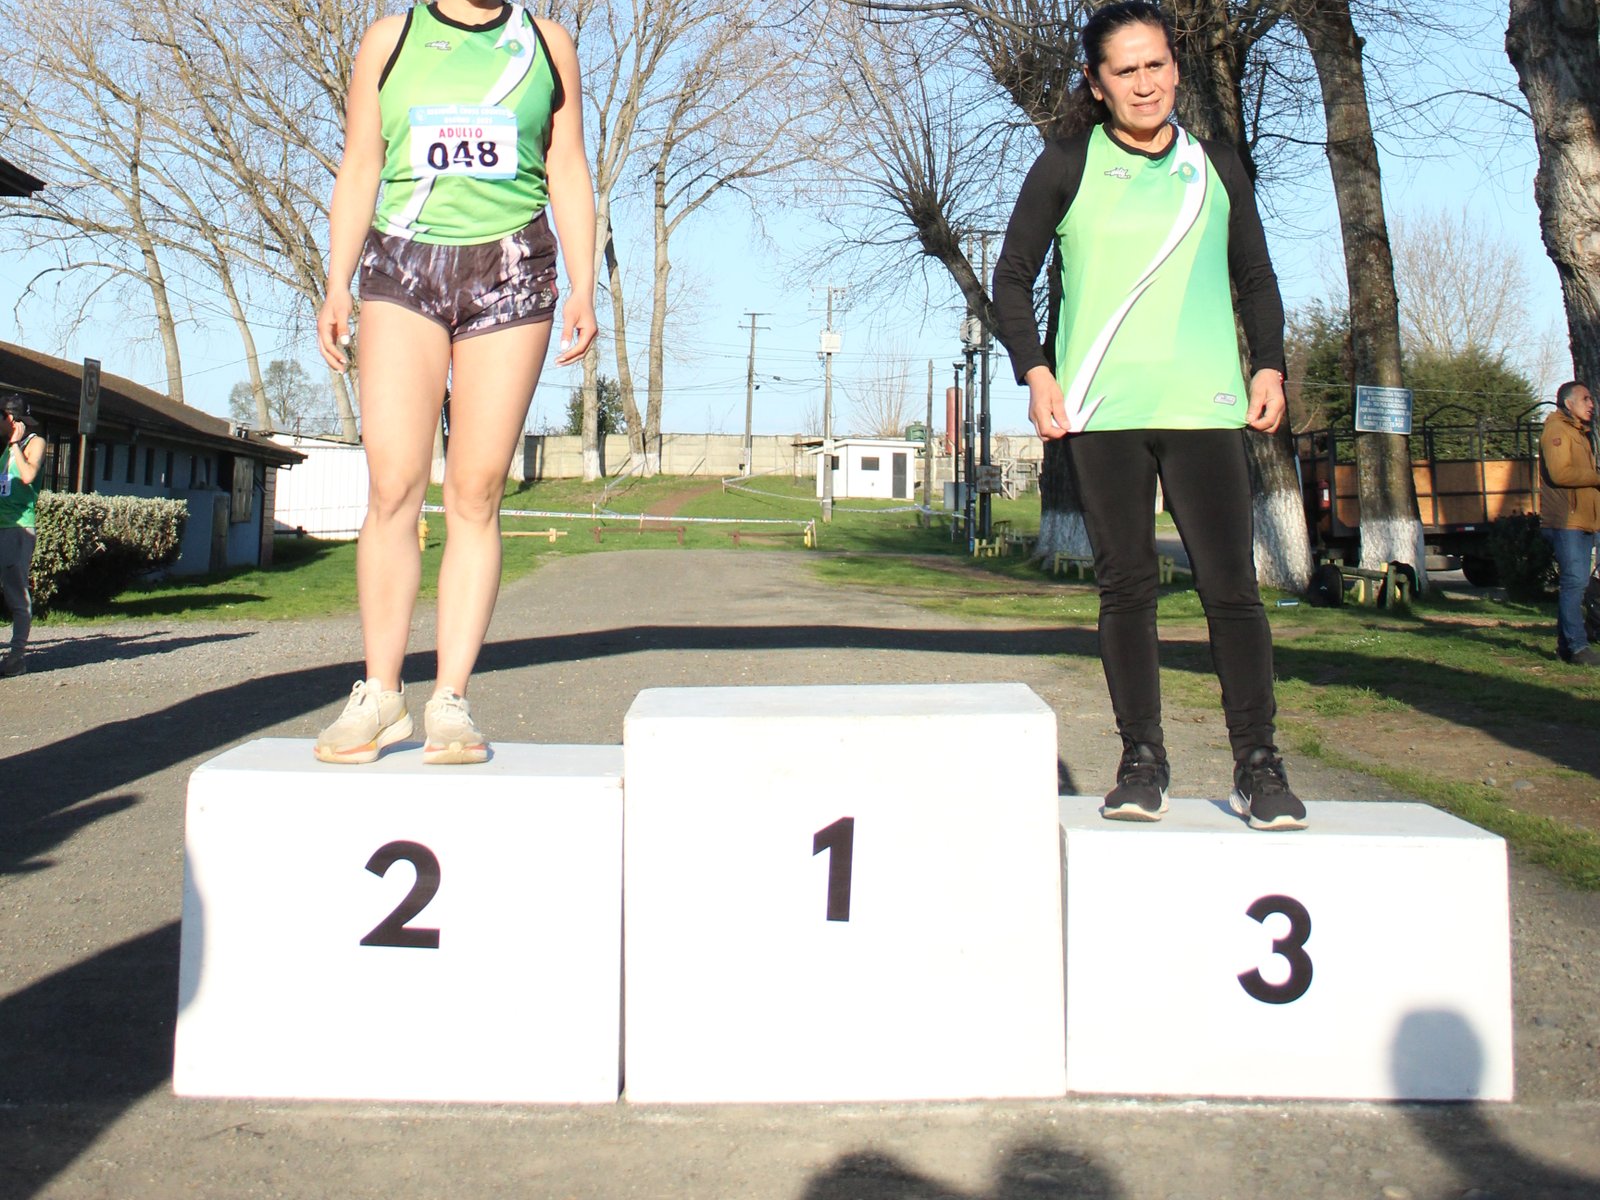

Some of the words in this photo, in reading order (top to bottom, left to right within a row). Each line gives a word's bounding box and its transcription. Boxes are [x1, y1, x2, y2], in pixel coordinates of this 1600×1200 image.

[427, 140, 499, 170] 048
[359, 841, 441, 949] 2
[812, 817, 855, 922] 1
[1238, 895, 1313, 1005] 3
